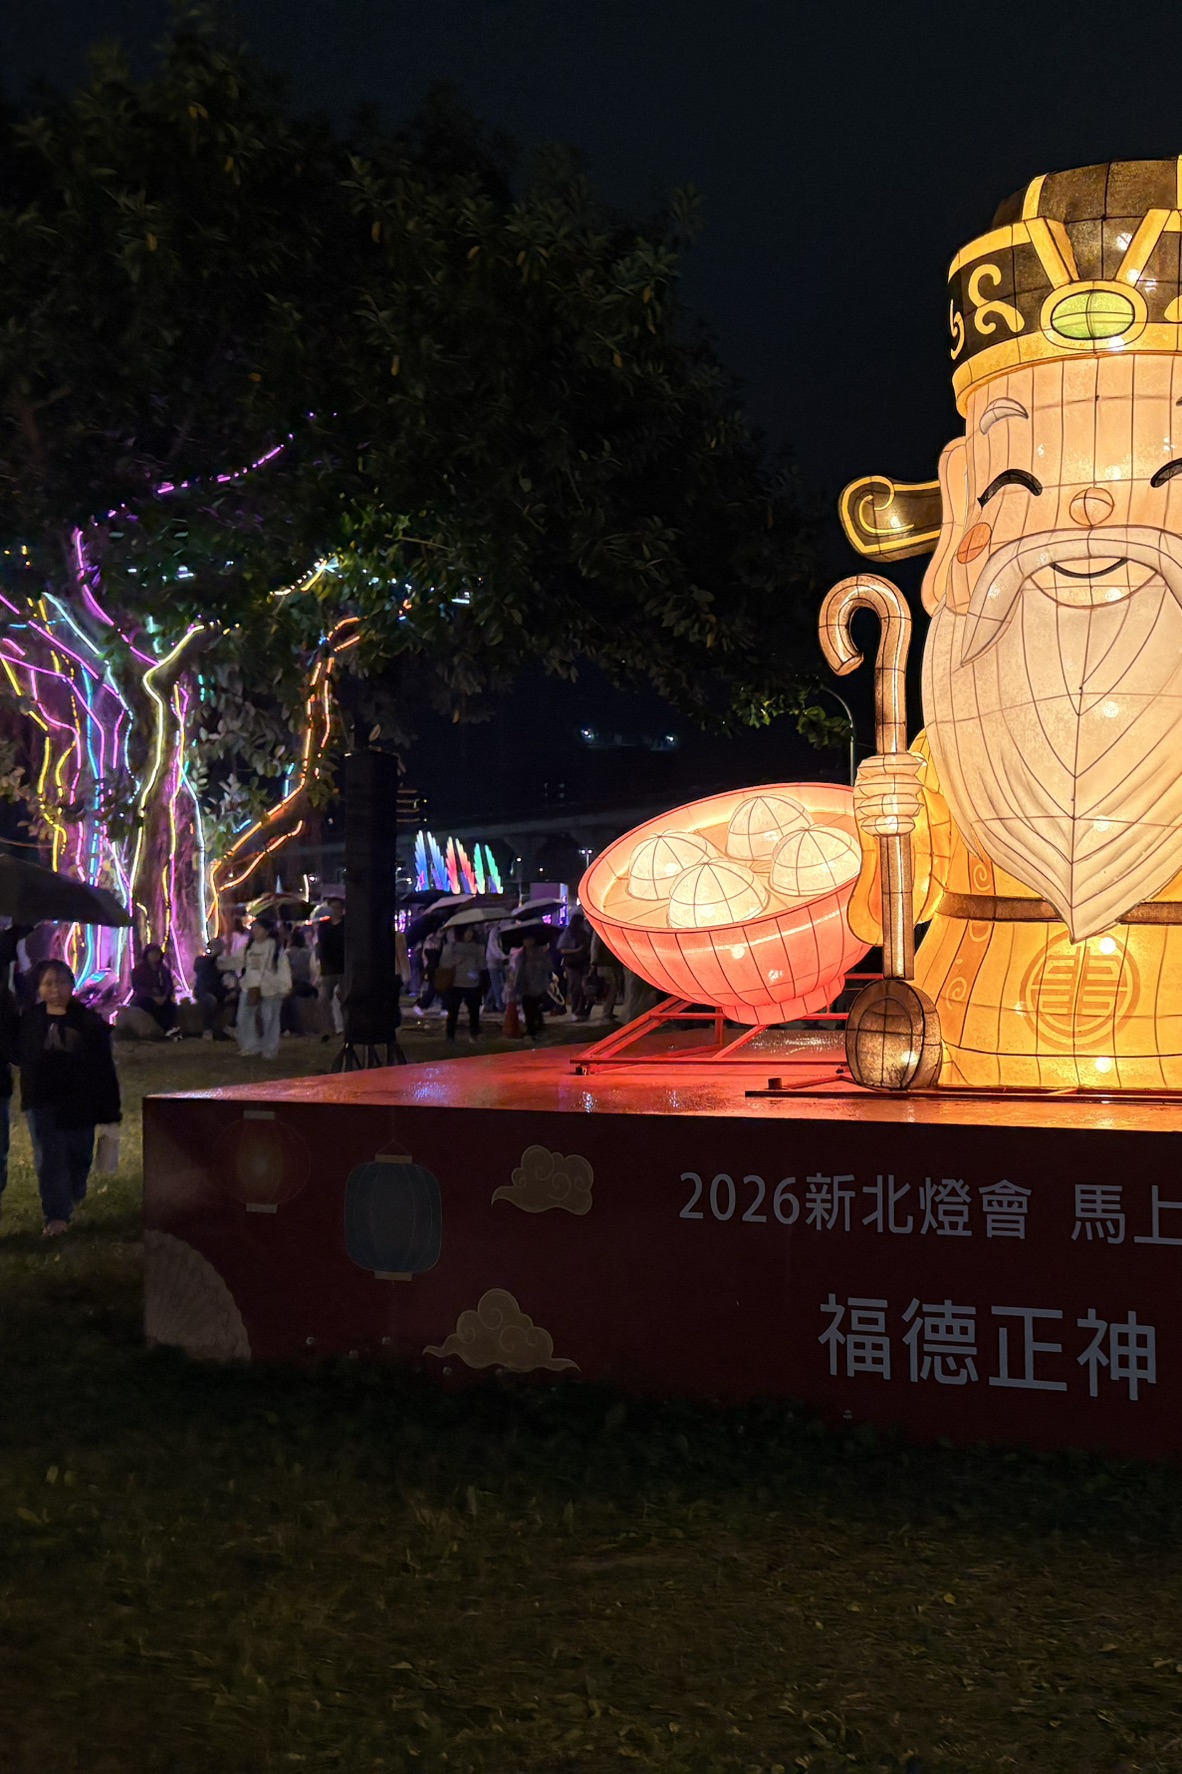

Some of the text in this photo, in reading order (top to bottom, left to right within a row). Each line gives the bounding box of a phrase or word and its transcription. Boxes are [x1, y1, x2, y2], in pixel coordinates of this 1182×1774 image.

[678, 1171, 1032, 1240] 2026新北燈會
[817, 1292, 1157, 1402] 福德正神
